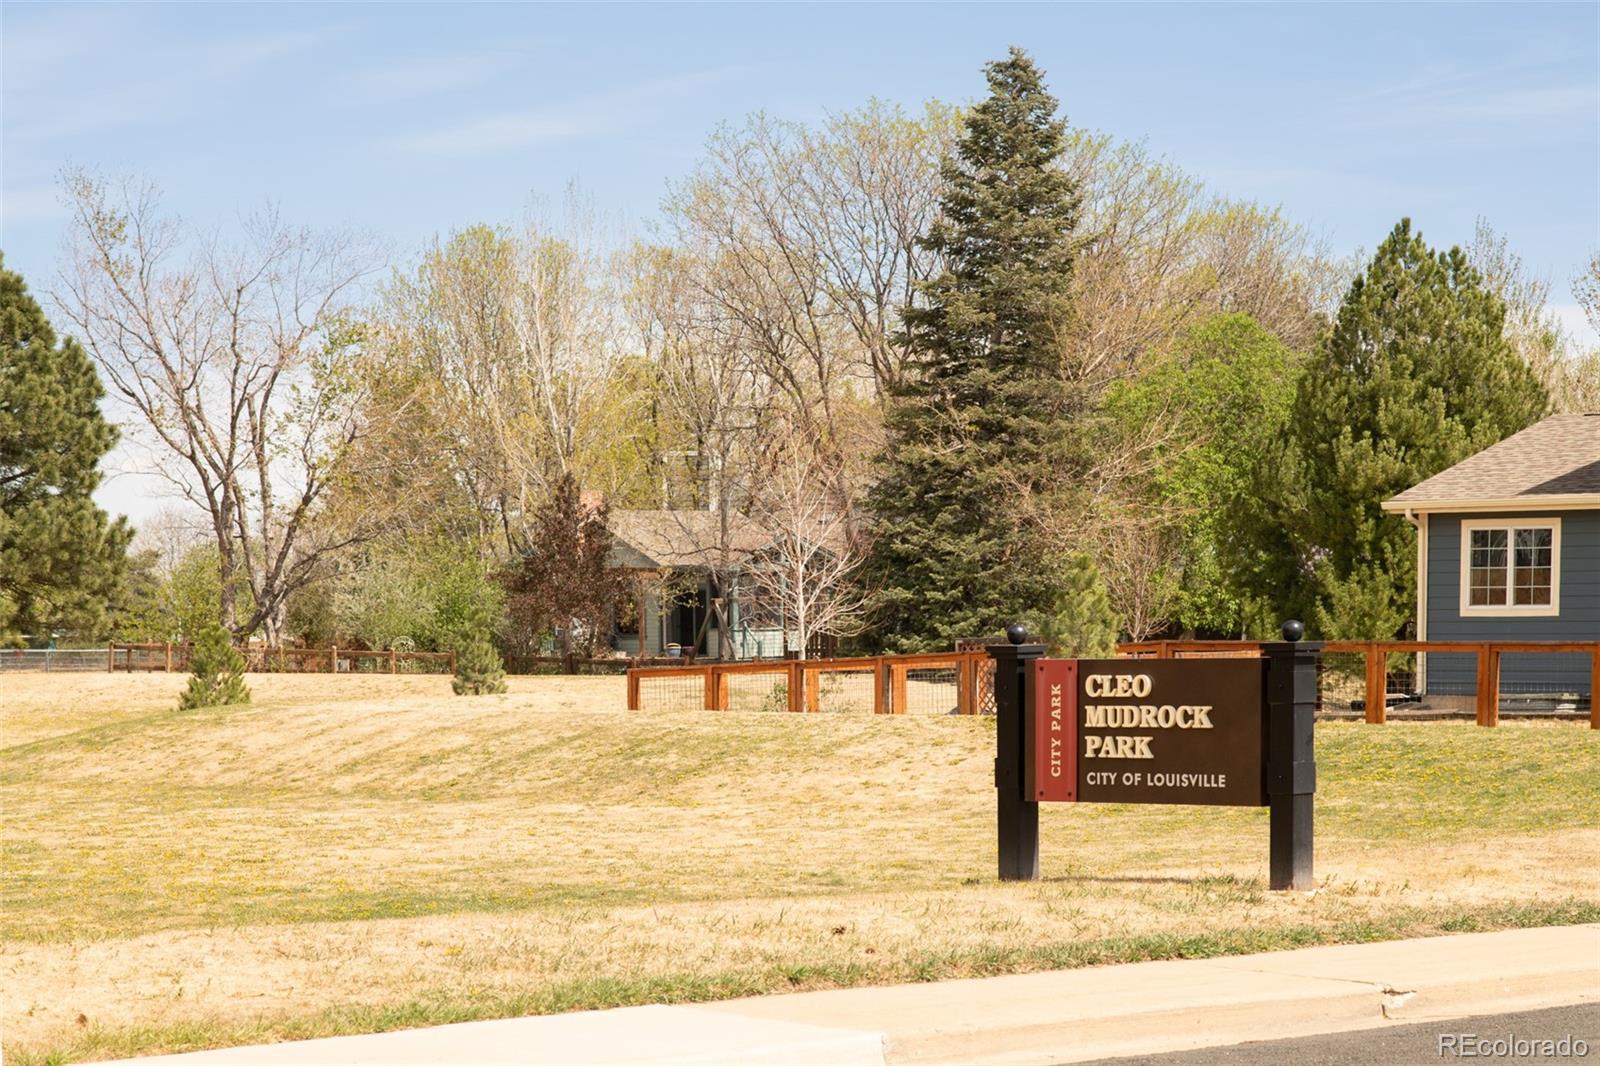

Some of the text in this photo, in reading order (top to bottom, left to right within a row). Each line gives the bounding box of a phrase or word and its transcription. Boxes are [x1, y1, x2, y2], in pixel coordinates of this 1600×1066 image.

[1084, 674, 1152, 698] CLEO
[1084, 705, 1214, 729] MUDROCK
[1050, 683, 1062, 778] CITY PARK
[1084, 735, 1154, 759] PARK
[1086, 772, 1226, 788] CITY OF LOUISVILLE
